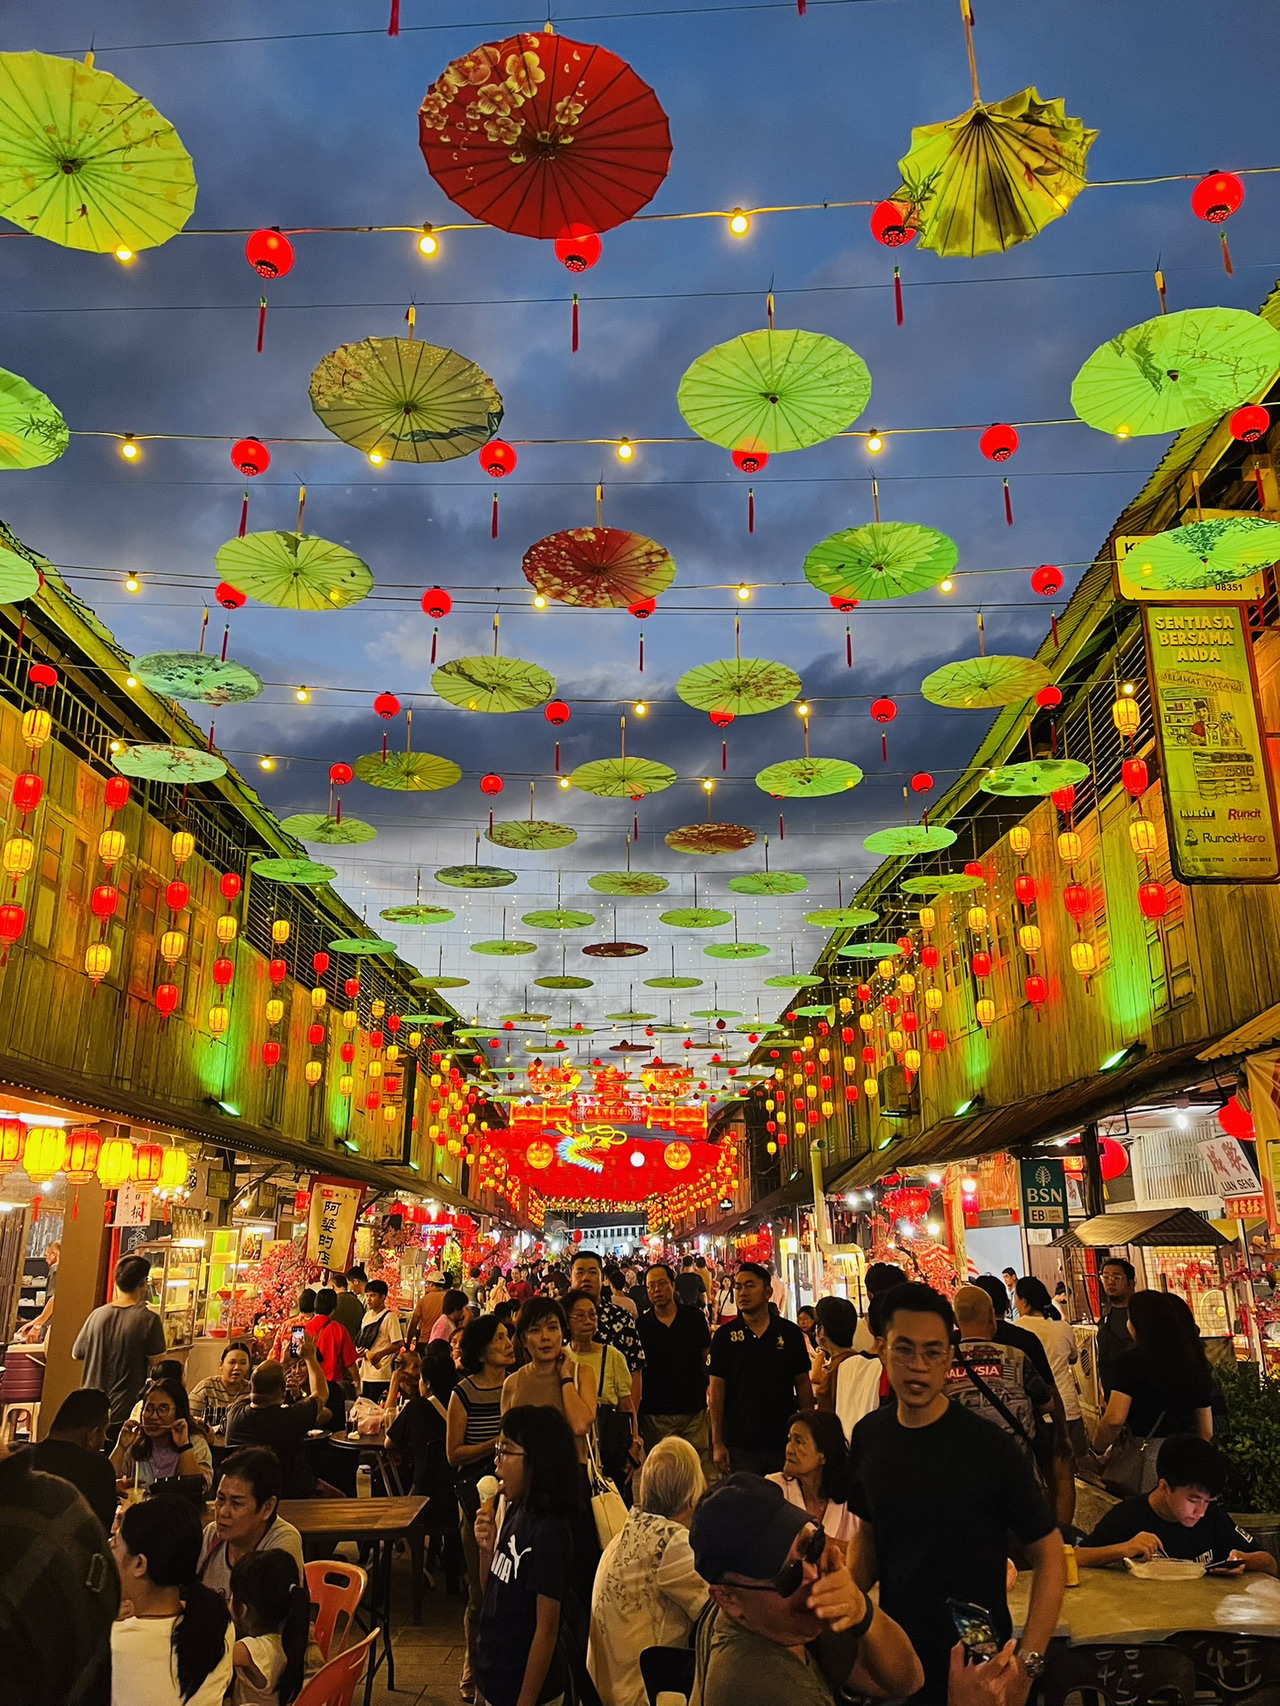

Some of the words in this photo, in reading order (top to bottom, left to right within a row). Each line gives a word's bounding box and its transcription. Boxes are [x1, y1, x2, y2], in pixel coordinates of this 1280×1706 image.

[1155, 614, 1235, 631] SENTIASA
[1159, 631, 1235, 647] BERSAMA
[1177, 647, 1222, 663] ANDA
[1163, 672, 1201, 685] SELAMAT
[1228, 808, 1262, 820] Runcit
[1203, 832, 1266, 844] RuncitHero
[1221, 1180, 1238, 1192] LIAN
[1237, 1178, 1256, 1190] SENG
[1026, 1187, 1063, 1203] BSN
[1031, 1209, 1045, 1222] EB
[946, 1365, 1000, 1379] ALASIA
